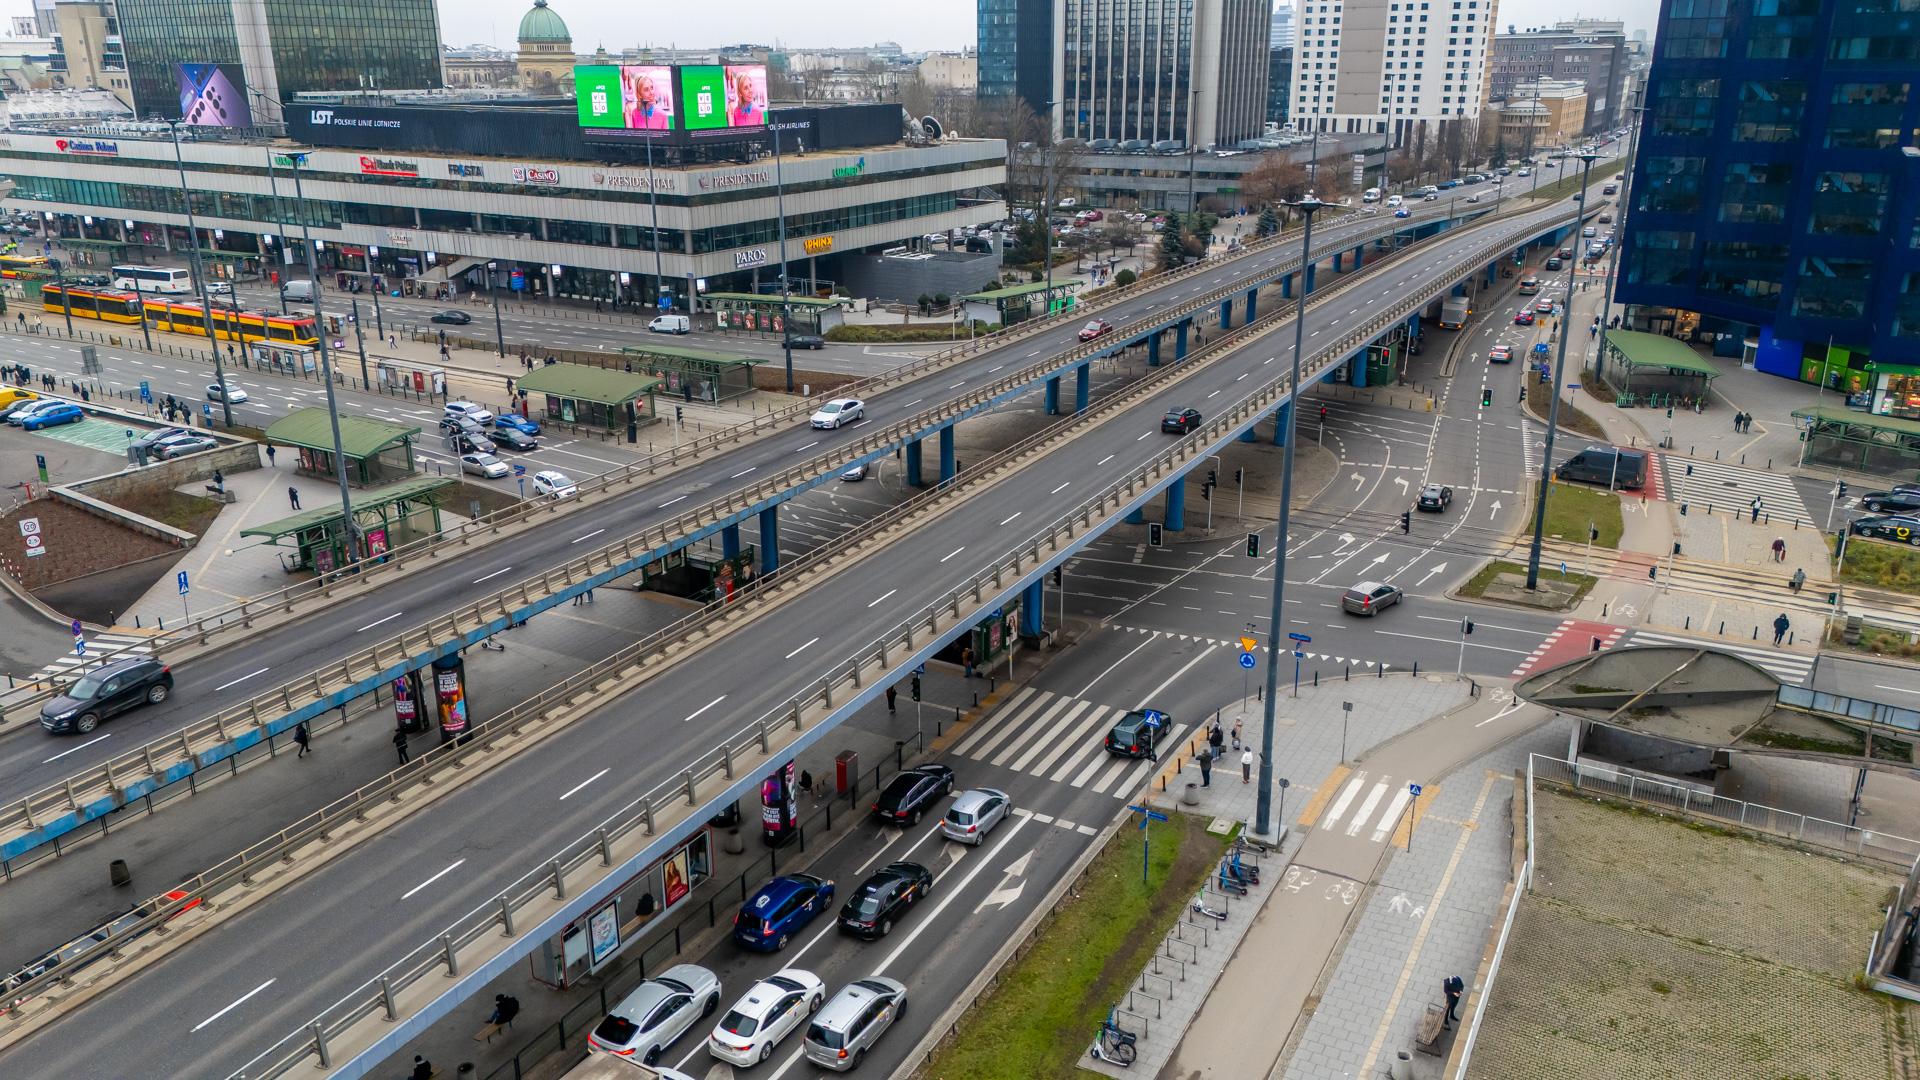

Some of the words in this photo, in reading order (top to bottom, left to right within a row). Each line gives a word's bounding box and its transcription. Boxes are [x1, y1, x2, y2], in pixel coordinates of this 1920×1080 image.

[311, 110, 334, 125] LOT
[334, 118, 357, 126] POLSKIE
[358, 119, 373, 127] LINIE
[374, 120, 401, 128] LOTNICZE
[786, 121, 810, 129] AIRLINES
[607, 175, 674, 189] PRESIDENTIAL
[713, 171, 769, 188] PRESIDENTIAL
[803, 235, 833, 249] SPHINX
[735, 248, 766, 264] PAROS
[26, 523, 36, 531] 20
